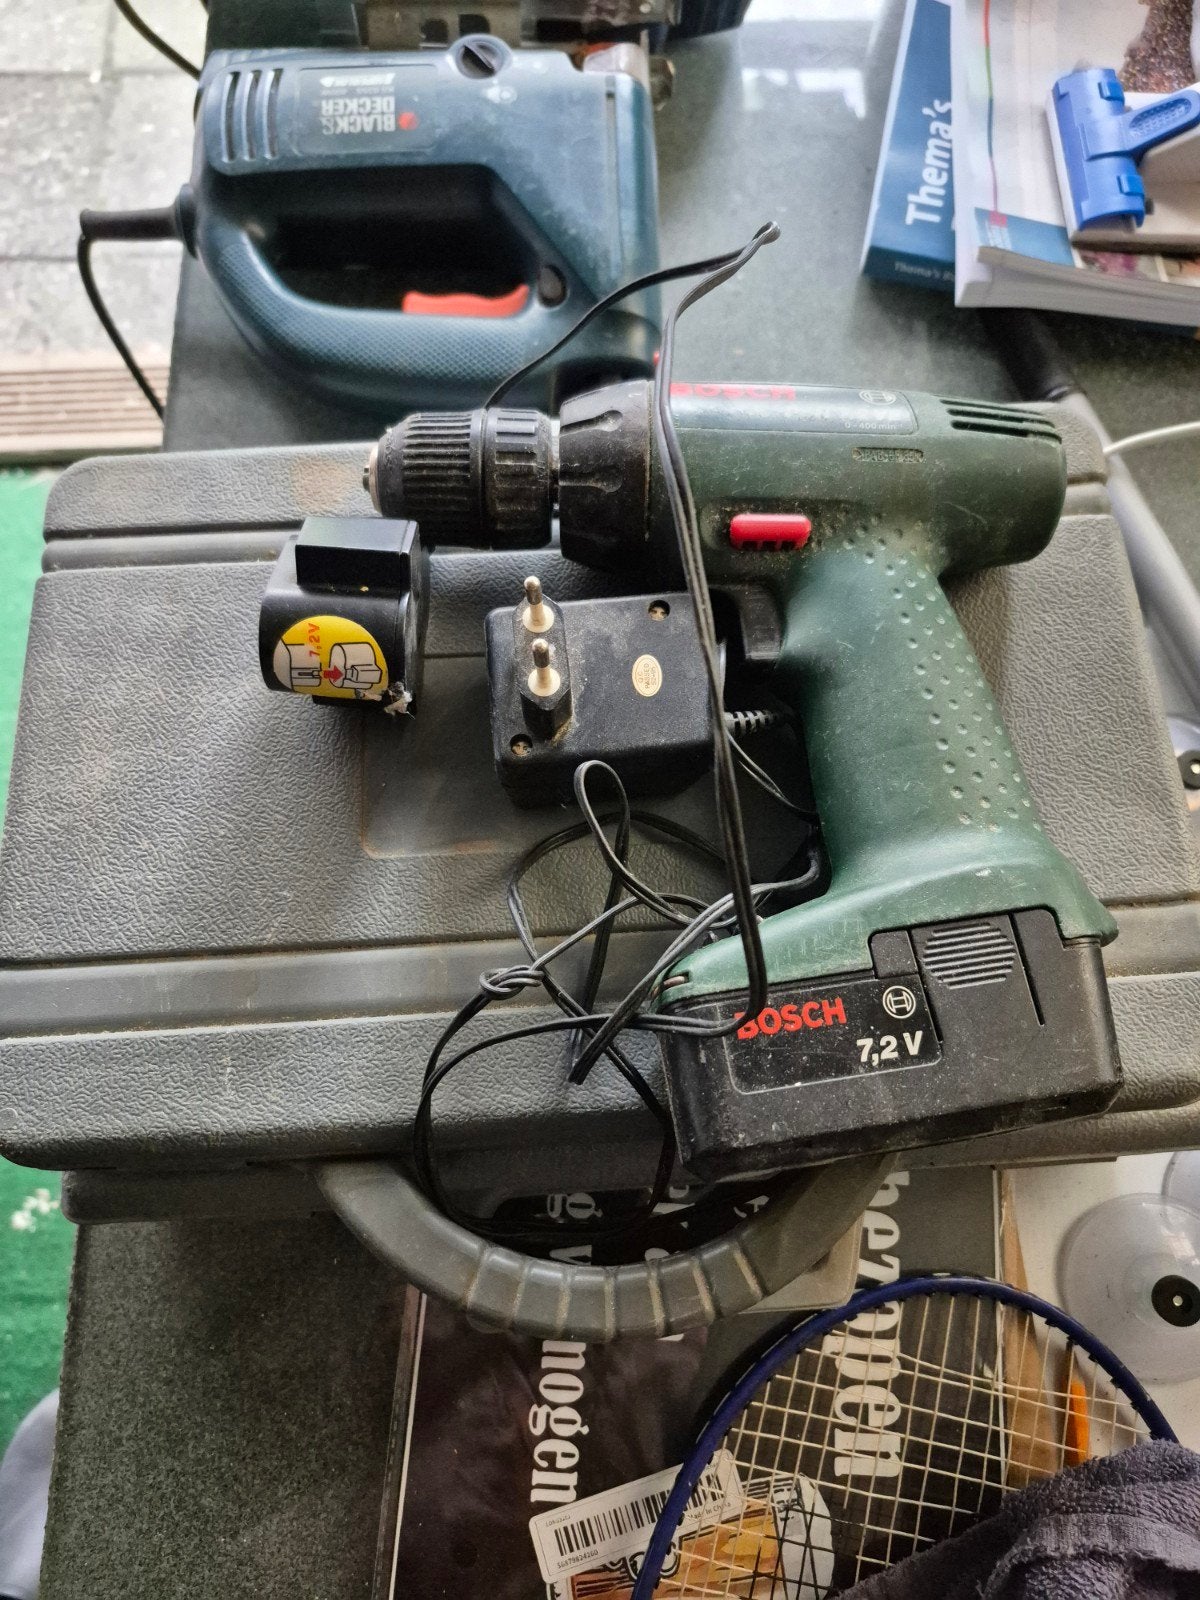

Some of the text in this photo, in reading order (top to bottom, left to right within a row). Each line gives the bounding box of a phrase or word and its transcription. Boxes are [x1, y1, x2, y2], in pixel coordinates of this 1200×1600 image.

[321, 97, 396, 115] DECKER
[905, 99, 953, 226] Thema's
[669, 382, 796, 401] BOSCH
[856, 1030, 923, 1066] 7,2 V
